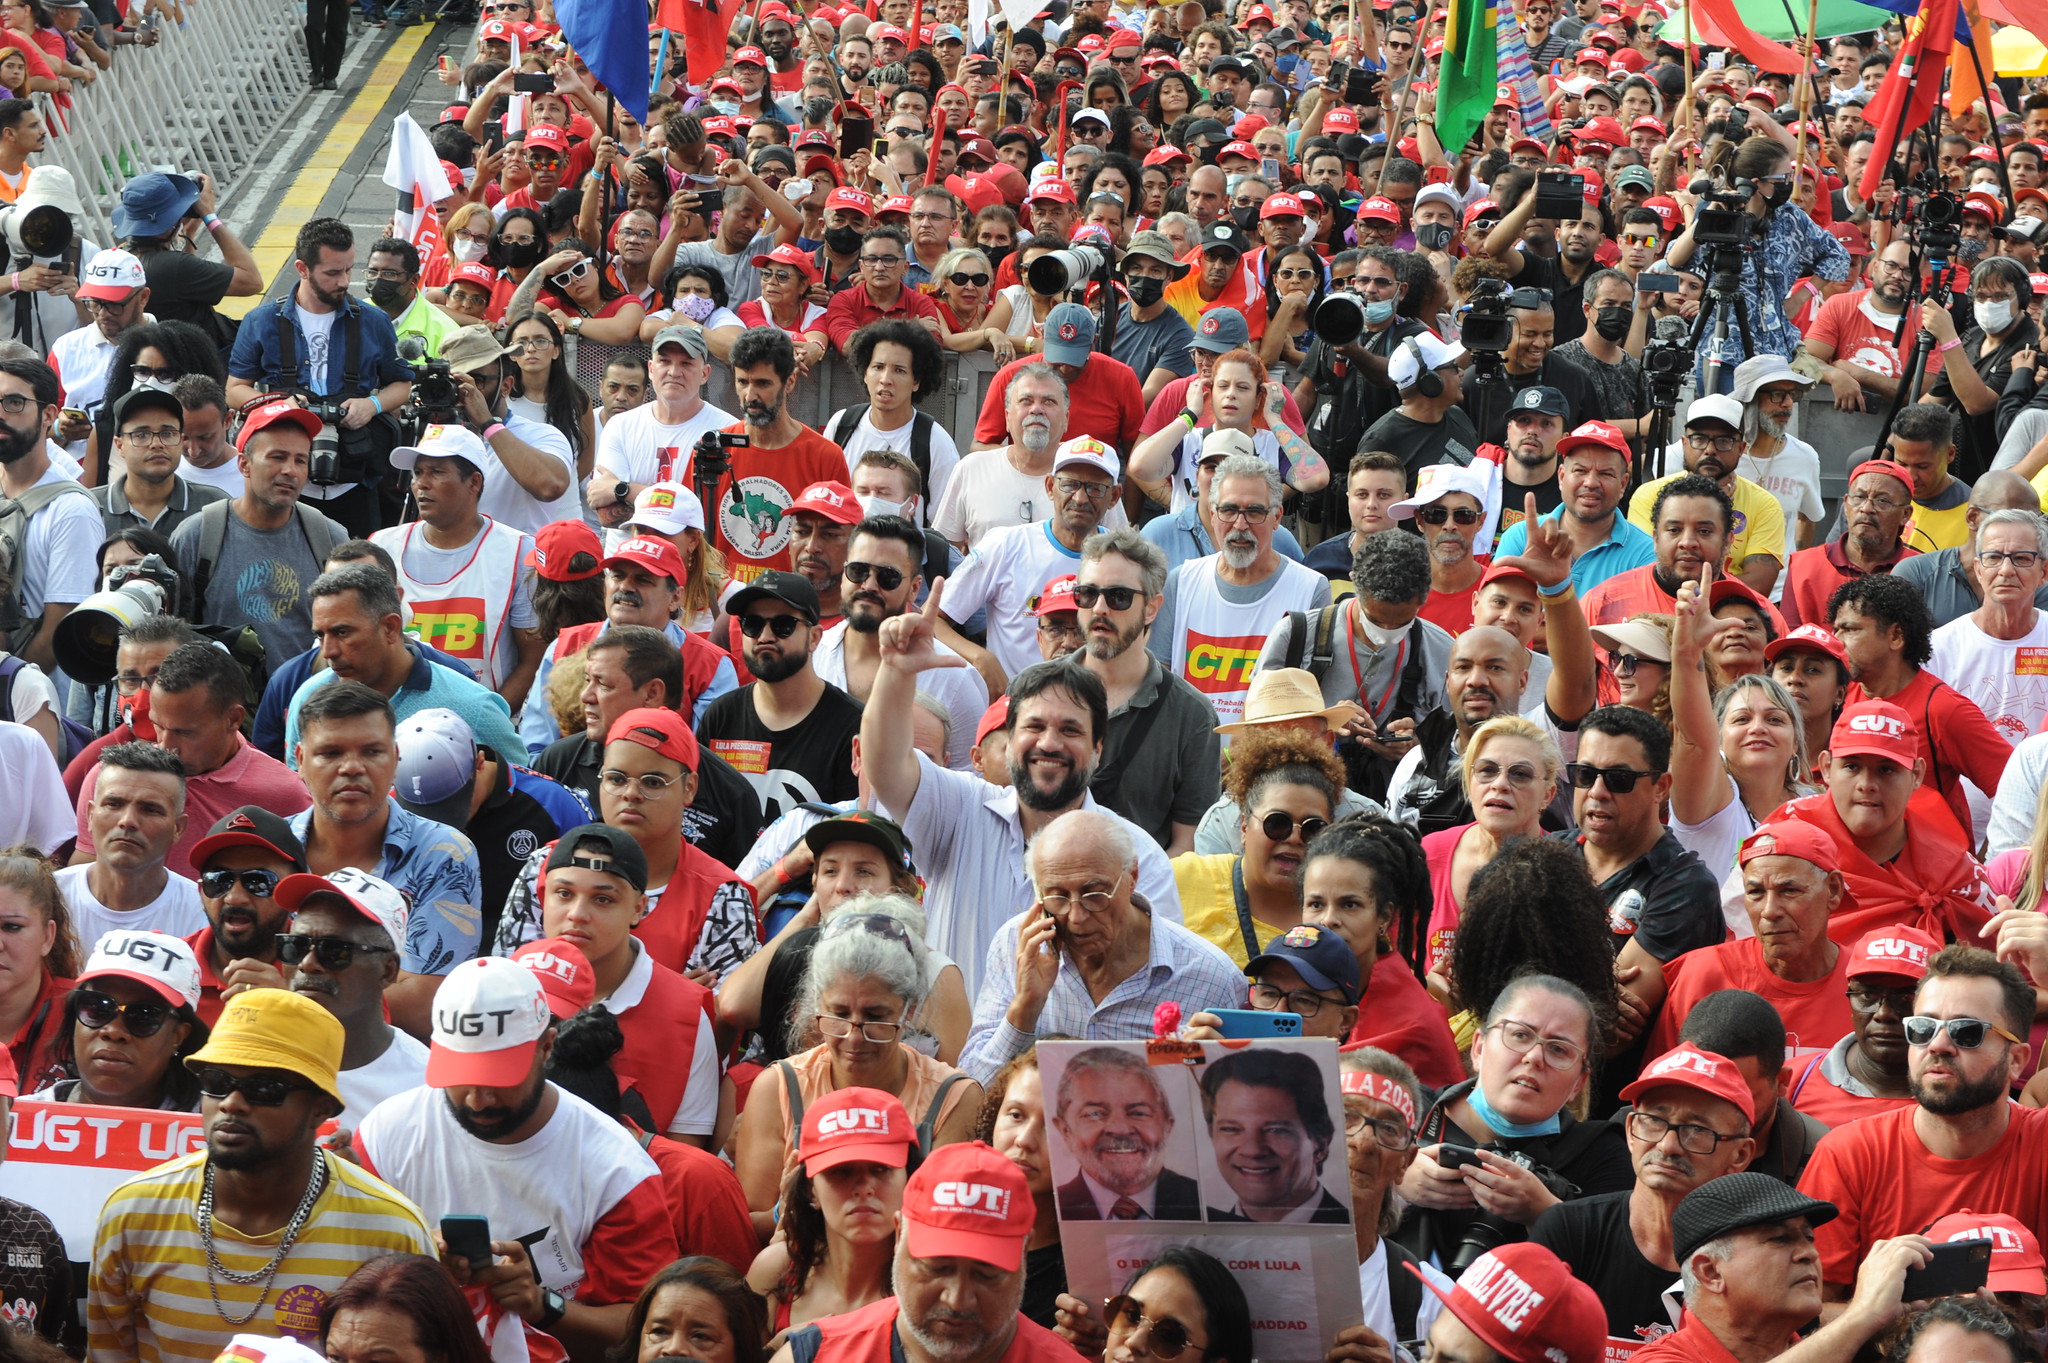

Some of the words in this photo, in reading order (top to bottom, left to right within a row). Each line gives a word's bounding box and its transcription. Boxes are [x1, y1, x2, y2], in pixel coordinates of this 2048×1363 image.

[530, 129, 559, 141] CUT
[838, 190, 867, 205] CUT
[1270, 197, 1298, 210] CUT
[1365, 200, 1393, 212] CUT
[462, 266, 491, 281] CUT
[806, 487, 845, 506] CUT
[619, 539, 663, 557] CUT
[404, 612, 481, 652] TB
[1849, 714, 1904, 736] CUT
[716, 741, 730, 751] LULA
[730, 741, 764, 753] PRESIDENTE
[103, 937, 184, 973] UGT
[1866, 937, 1925, 962] CUT
[517, 951, 575, 978] CUT
[440, 1009, 516, 1038] UGT
[1651, 1050, 1713, 1076] CUT
[817, 1107, 881, 1134] CUT
[9, 1108, 125, 1160] UGT
[139, 1119, 209, 1161] UG
[932, 1181, 1004, 1211] CUT
[7, 1253, 44, 1268] BRASIL
[550, 1234, 569, 1273] BRASIL
[1116, 1259, 1128, 1269] O
[1228, 1260, 1261, 1271] COM
[1264, 1260, 1302, 1271] LULA
